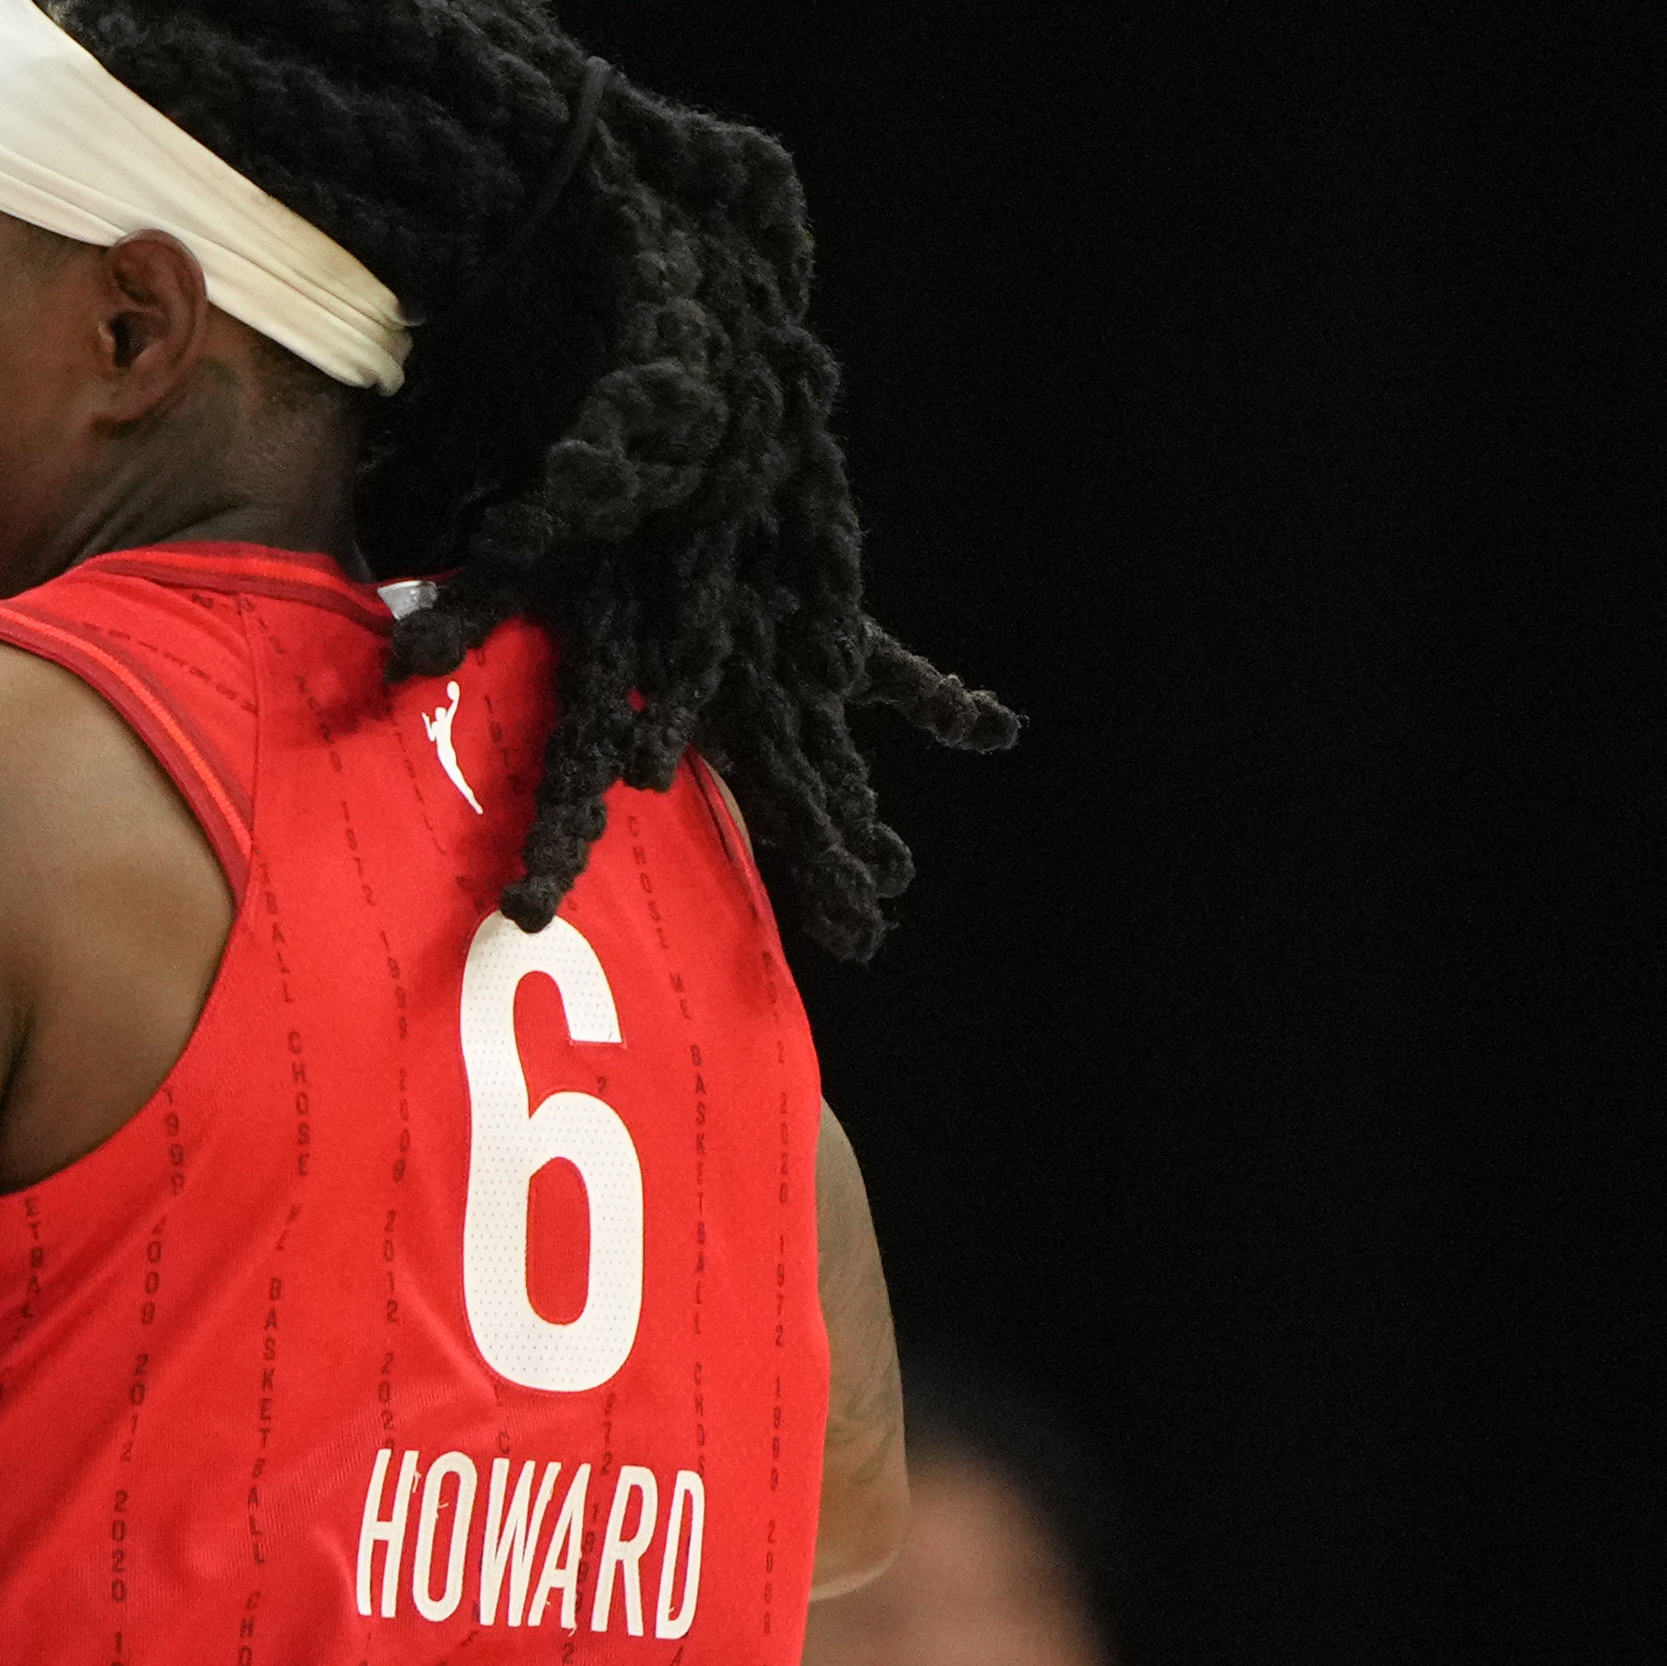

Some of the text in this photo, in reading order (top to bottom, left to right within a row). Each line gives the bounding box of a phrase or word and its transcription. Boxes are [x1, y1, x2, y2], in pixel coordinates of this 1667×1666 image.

[287, 1029, 311, 1178] CHOSE
[461, 909, 643, 1394] 6
[628, 814, 669, 950] CHOSE
[690, 1044, 706, 1336] BASKETBALL
[383, 1208, 398, 1323] 2012
[119, 1352, 150, 1463] 2012
[247, 1277, 283, 1566] BASKETBALL
[111, 1488, 129, 1604] 2020
[355, 1448, 707, 1640] HOWARD
